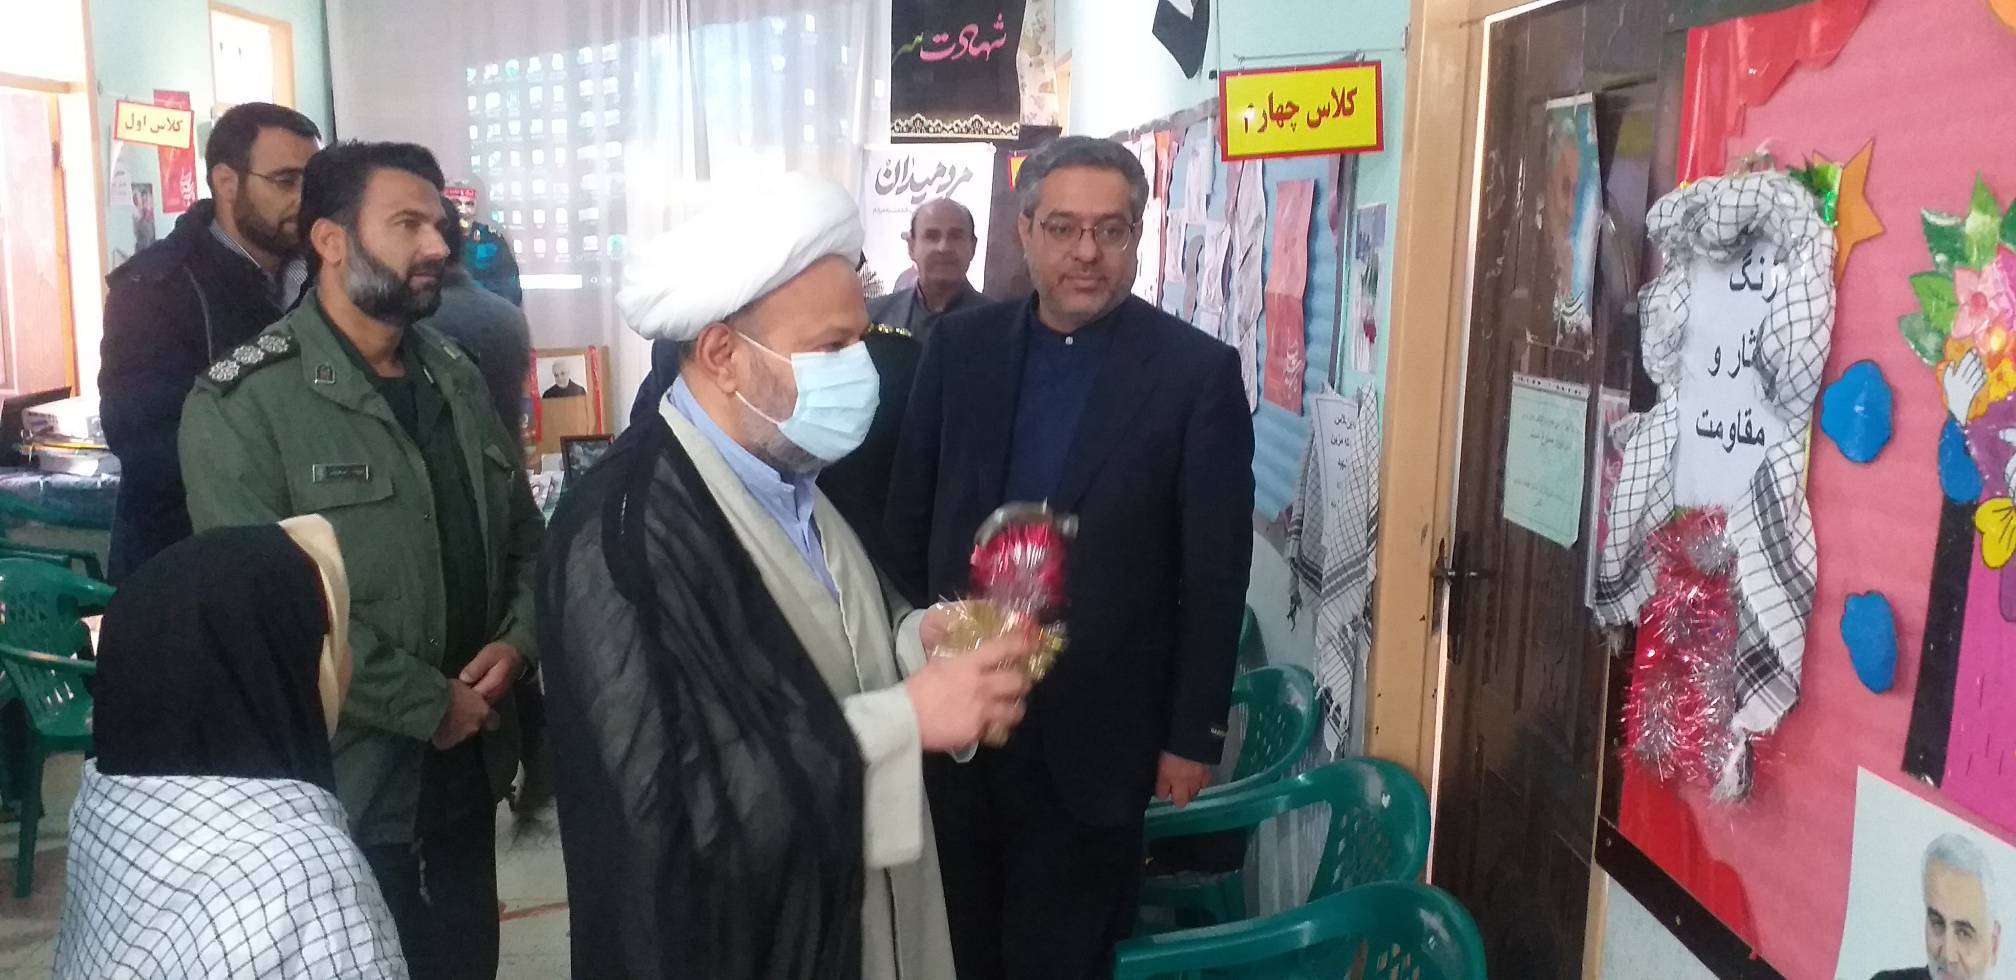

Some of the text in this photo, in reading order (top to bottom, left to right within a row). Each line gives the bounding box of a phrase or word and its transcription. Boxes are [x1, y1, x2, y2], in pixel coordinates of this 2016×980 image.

[920, 12, 1007, 62] شهادت
[125, 112, 184, 134] کلاس اول
[1306, 86, 1358, 129] کلاس
[875, 154, 947, 205] میدان
[1707, 328, 1757, 379] ثار و
[1695, 408, 1766, 454] مقاومت
